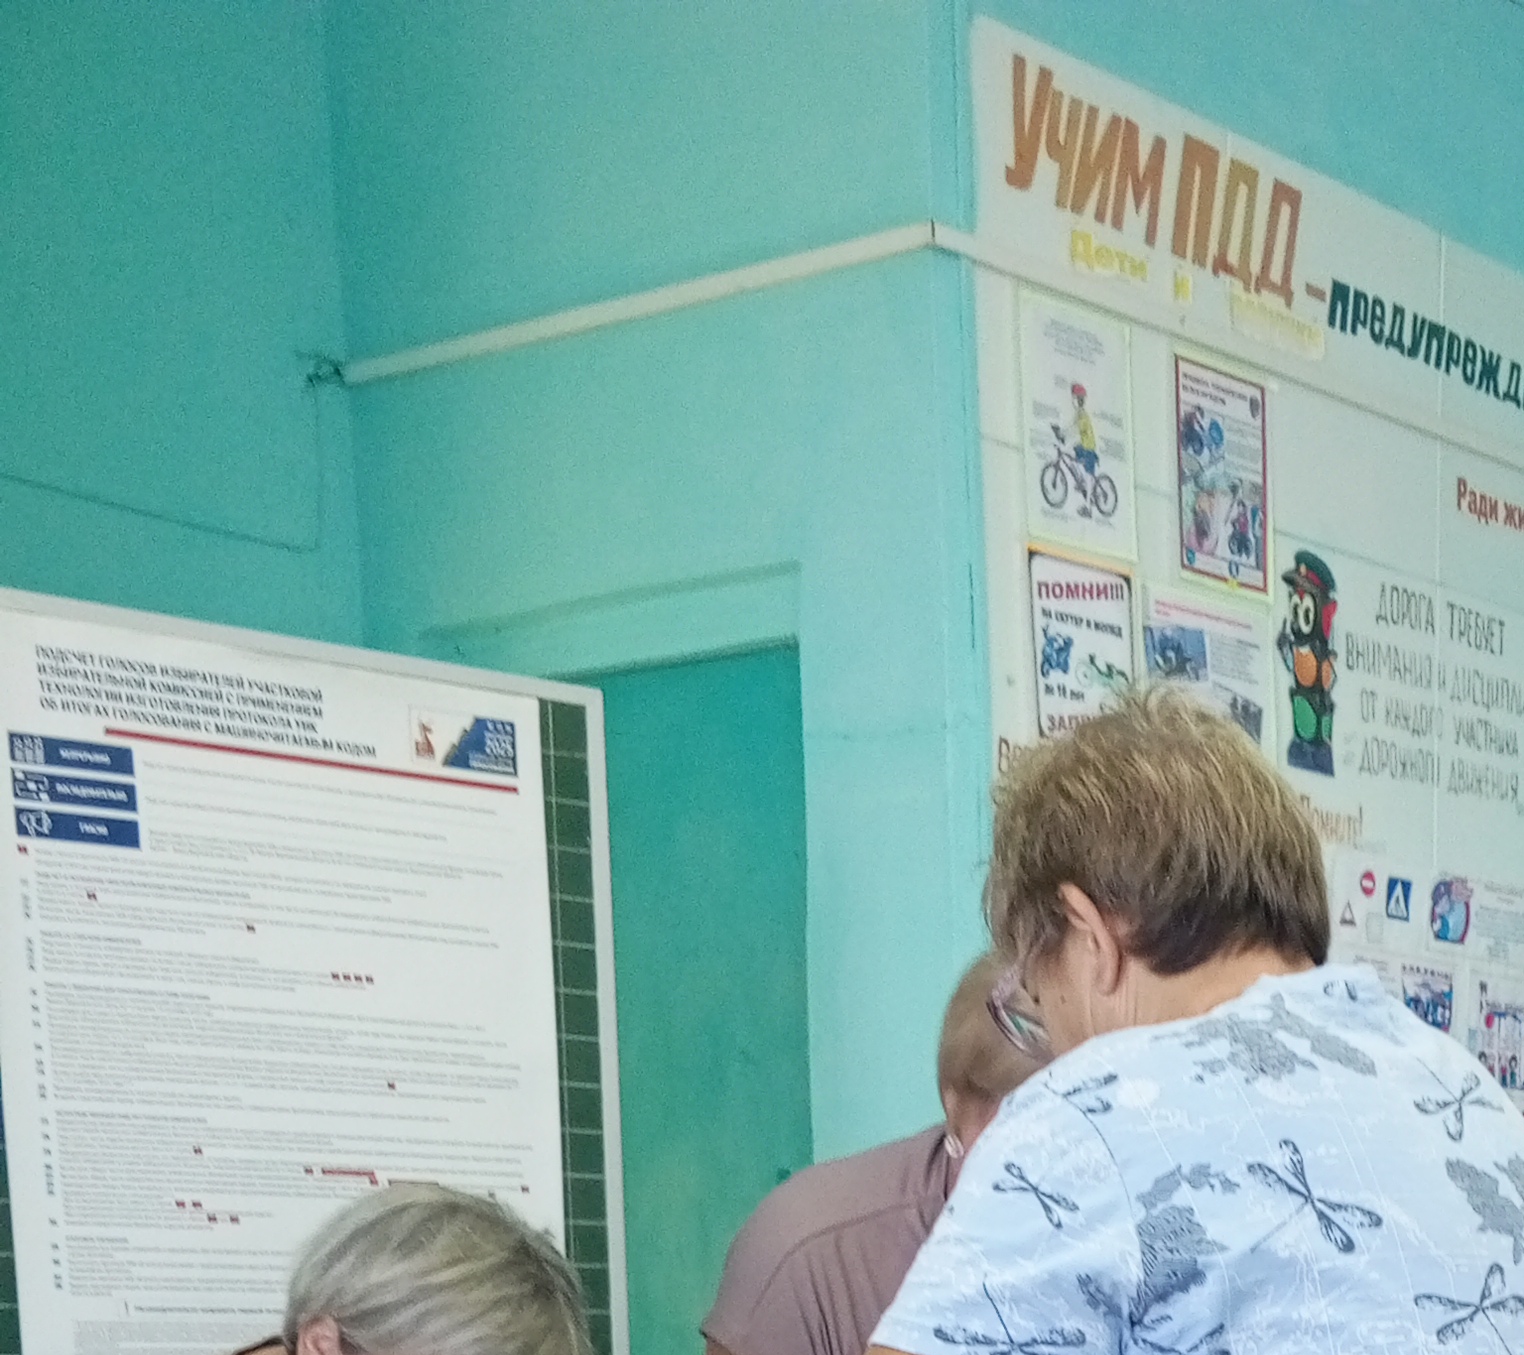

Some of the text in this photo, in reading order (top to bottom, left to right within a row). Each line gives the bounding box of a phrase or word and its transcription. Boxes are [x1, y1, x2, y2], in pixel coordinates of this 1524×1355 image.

[1005, 54, 1167, 249] УЧИМ
[1172, 134, 1303, 309] ПДД
[1457, 477, 1499, 525] Ради
[1375, 581, 1506, 657] ДОРОГА ТРЕБУЕТ
[1345, 631, 1433, 691] ВНИМАНИЯ
[1360, 687, 1378, 724] ОТ
